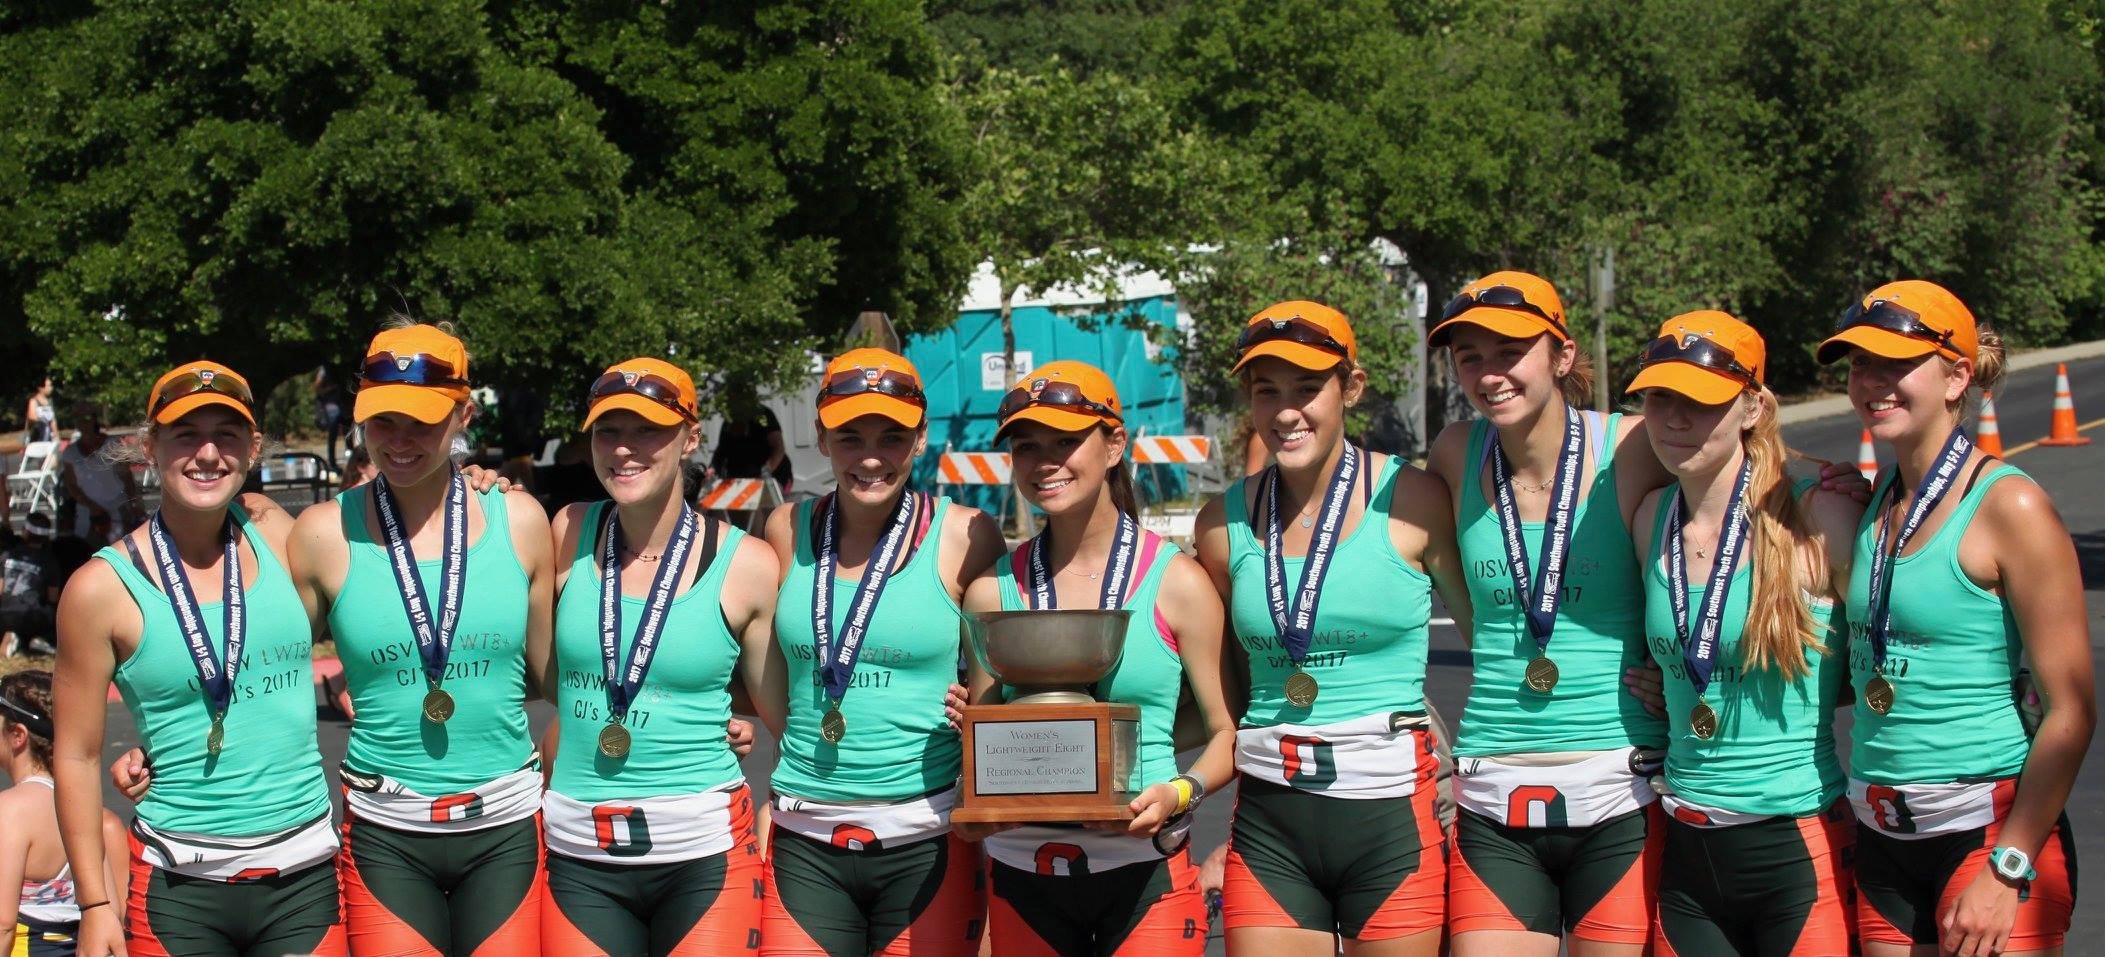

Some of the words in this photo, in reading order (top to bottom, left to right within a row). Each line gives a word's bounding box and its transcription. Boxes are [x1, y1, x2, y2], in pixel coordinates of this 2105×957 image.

[1570, 425, 1580, 436] 5-7
[1568, 436, 1581, 452] May
[1340, 464, 1354, 479] May
[1558, 454, 1579, 510] Championships,
[452, 488, 463, 503] May
[1500, 483, 1510, 505] Youth
[1909, 477, 1948, 528] Championships,
[1938, 461, 1956, 477] May
[377, 491, 396, 528] Southwest
[897, 508, 909, 523] May
[1322, 480, 1350, 532] Championships,
[679, 523, 692, 539] May
[1554, 511, 1568, 531] Youth
[389, 525, 402, 547] Youth
[1316, 532, 1332, 552] Youth
[1503, 505, 1521, 562] Championships,
[152, 531, 173, 565] Southwest
[820, 547, 830, 566] Youth
[874, 524, 904, 572] Championships,
[1548, 533, 1564, 571] Southwest
[394, 546, 417, 598] Championships,
[449, 554, 461, 573] Youth
[660, 539, 688, 590] Championships,
[1108, 545, 1131, 595] Championships,
[1121, 529, 1134, 544] May
[1305, 553, 1325, 589] Southwest
[1515, 561, 1525, 577] May
[166, 563, 180, 584] Youth
[866, 571, 883, 591] Youth
[1036, 571, 1048, 592] Youth
[230, 587, 240, 604] Youth
[445, 573, 459, 609] Southwest
[653, 589, 668, 609] Youth
[816, 566, 830, 618] Championships,
[1270, 585, 1282, 601] May
[1672, 553, 1684, 611] Championships,
[1678, 611, 1686, 626] May
[172, 583, 198, 634] Championships,
[410, 597, 421, 613] May
[603, 578, 615, 631] Championships,
[852, 590, 875, 627] Southwest
[1541, 595, 1554, 612] 2017
[1697, 641, 1711, 659] 2017
[1707, 578, 1725, 617] Southwest
[1716, 556, 1732, 576] Youth
[230, 606, 241, 642] Southwest
[640, 609, 662, 646] Southwest
[817, 619, 826, 633] May
[1296, 611, 1309, 629] 2017
[191, 633, 204, 647] May
[441, 630, 449, 647] 2017
[604, 632, 614, 646] May
[838, 647, 852, 665] 2017
[444, 660, 490, 680] 2017
[629, 665, 641, 683] 2017
[848, 670, 892, 688] 2017
[263, 670, 299, 694] 2017
[574, 700, 599, 721] CJ's
